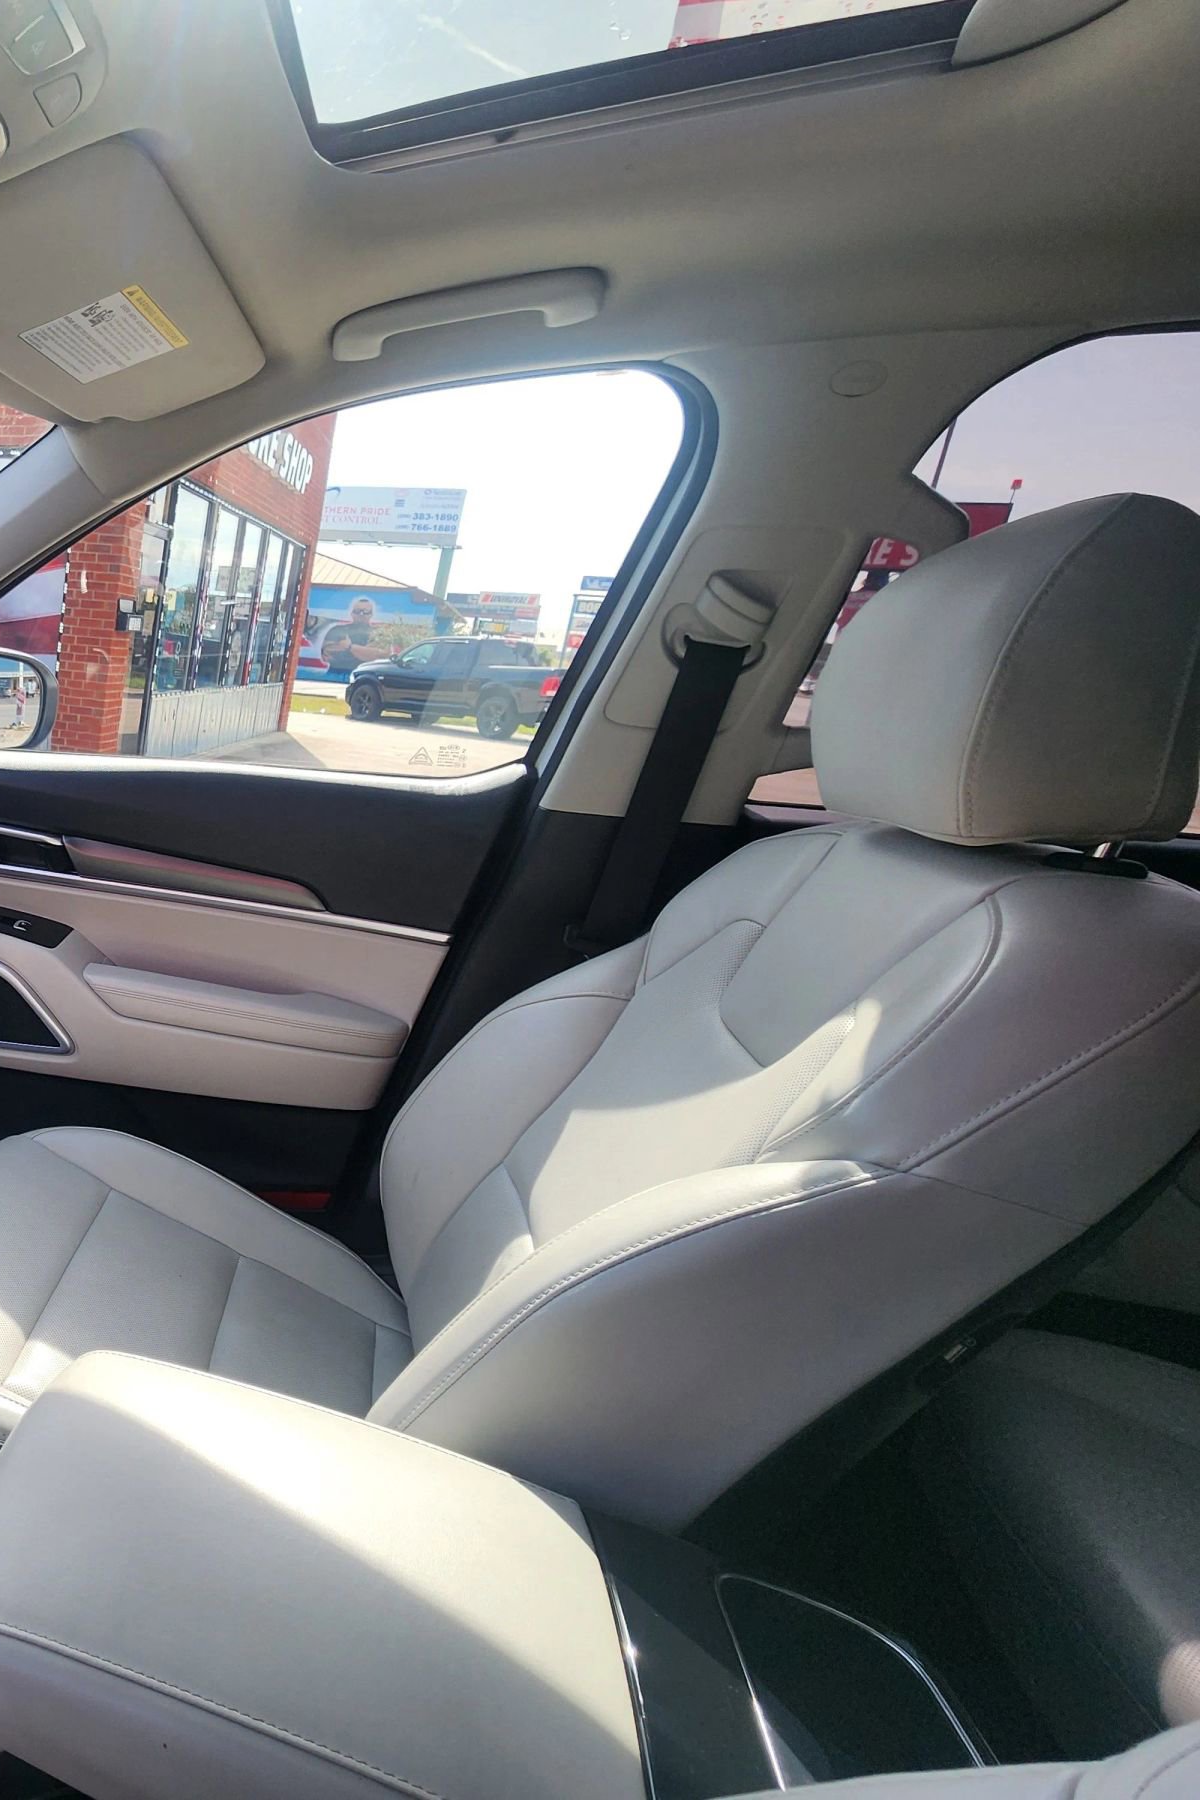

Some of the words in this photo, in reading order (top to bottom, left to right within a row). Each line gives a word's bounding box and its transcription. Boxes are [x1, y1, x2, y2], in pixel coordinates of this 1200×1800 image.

[279, 433, 313, 494] SHOP
[360, 507, 392, 515] PRIDE
[332, 515, 381, 525] CONTROL
[413, 512, 459, 522] 383-1890
